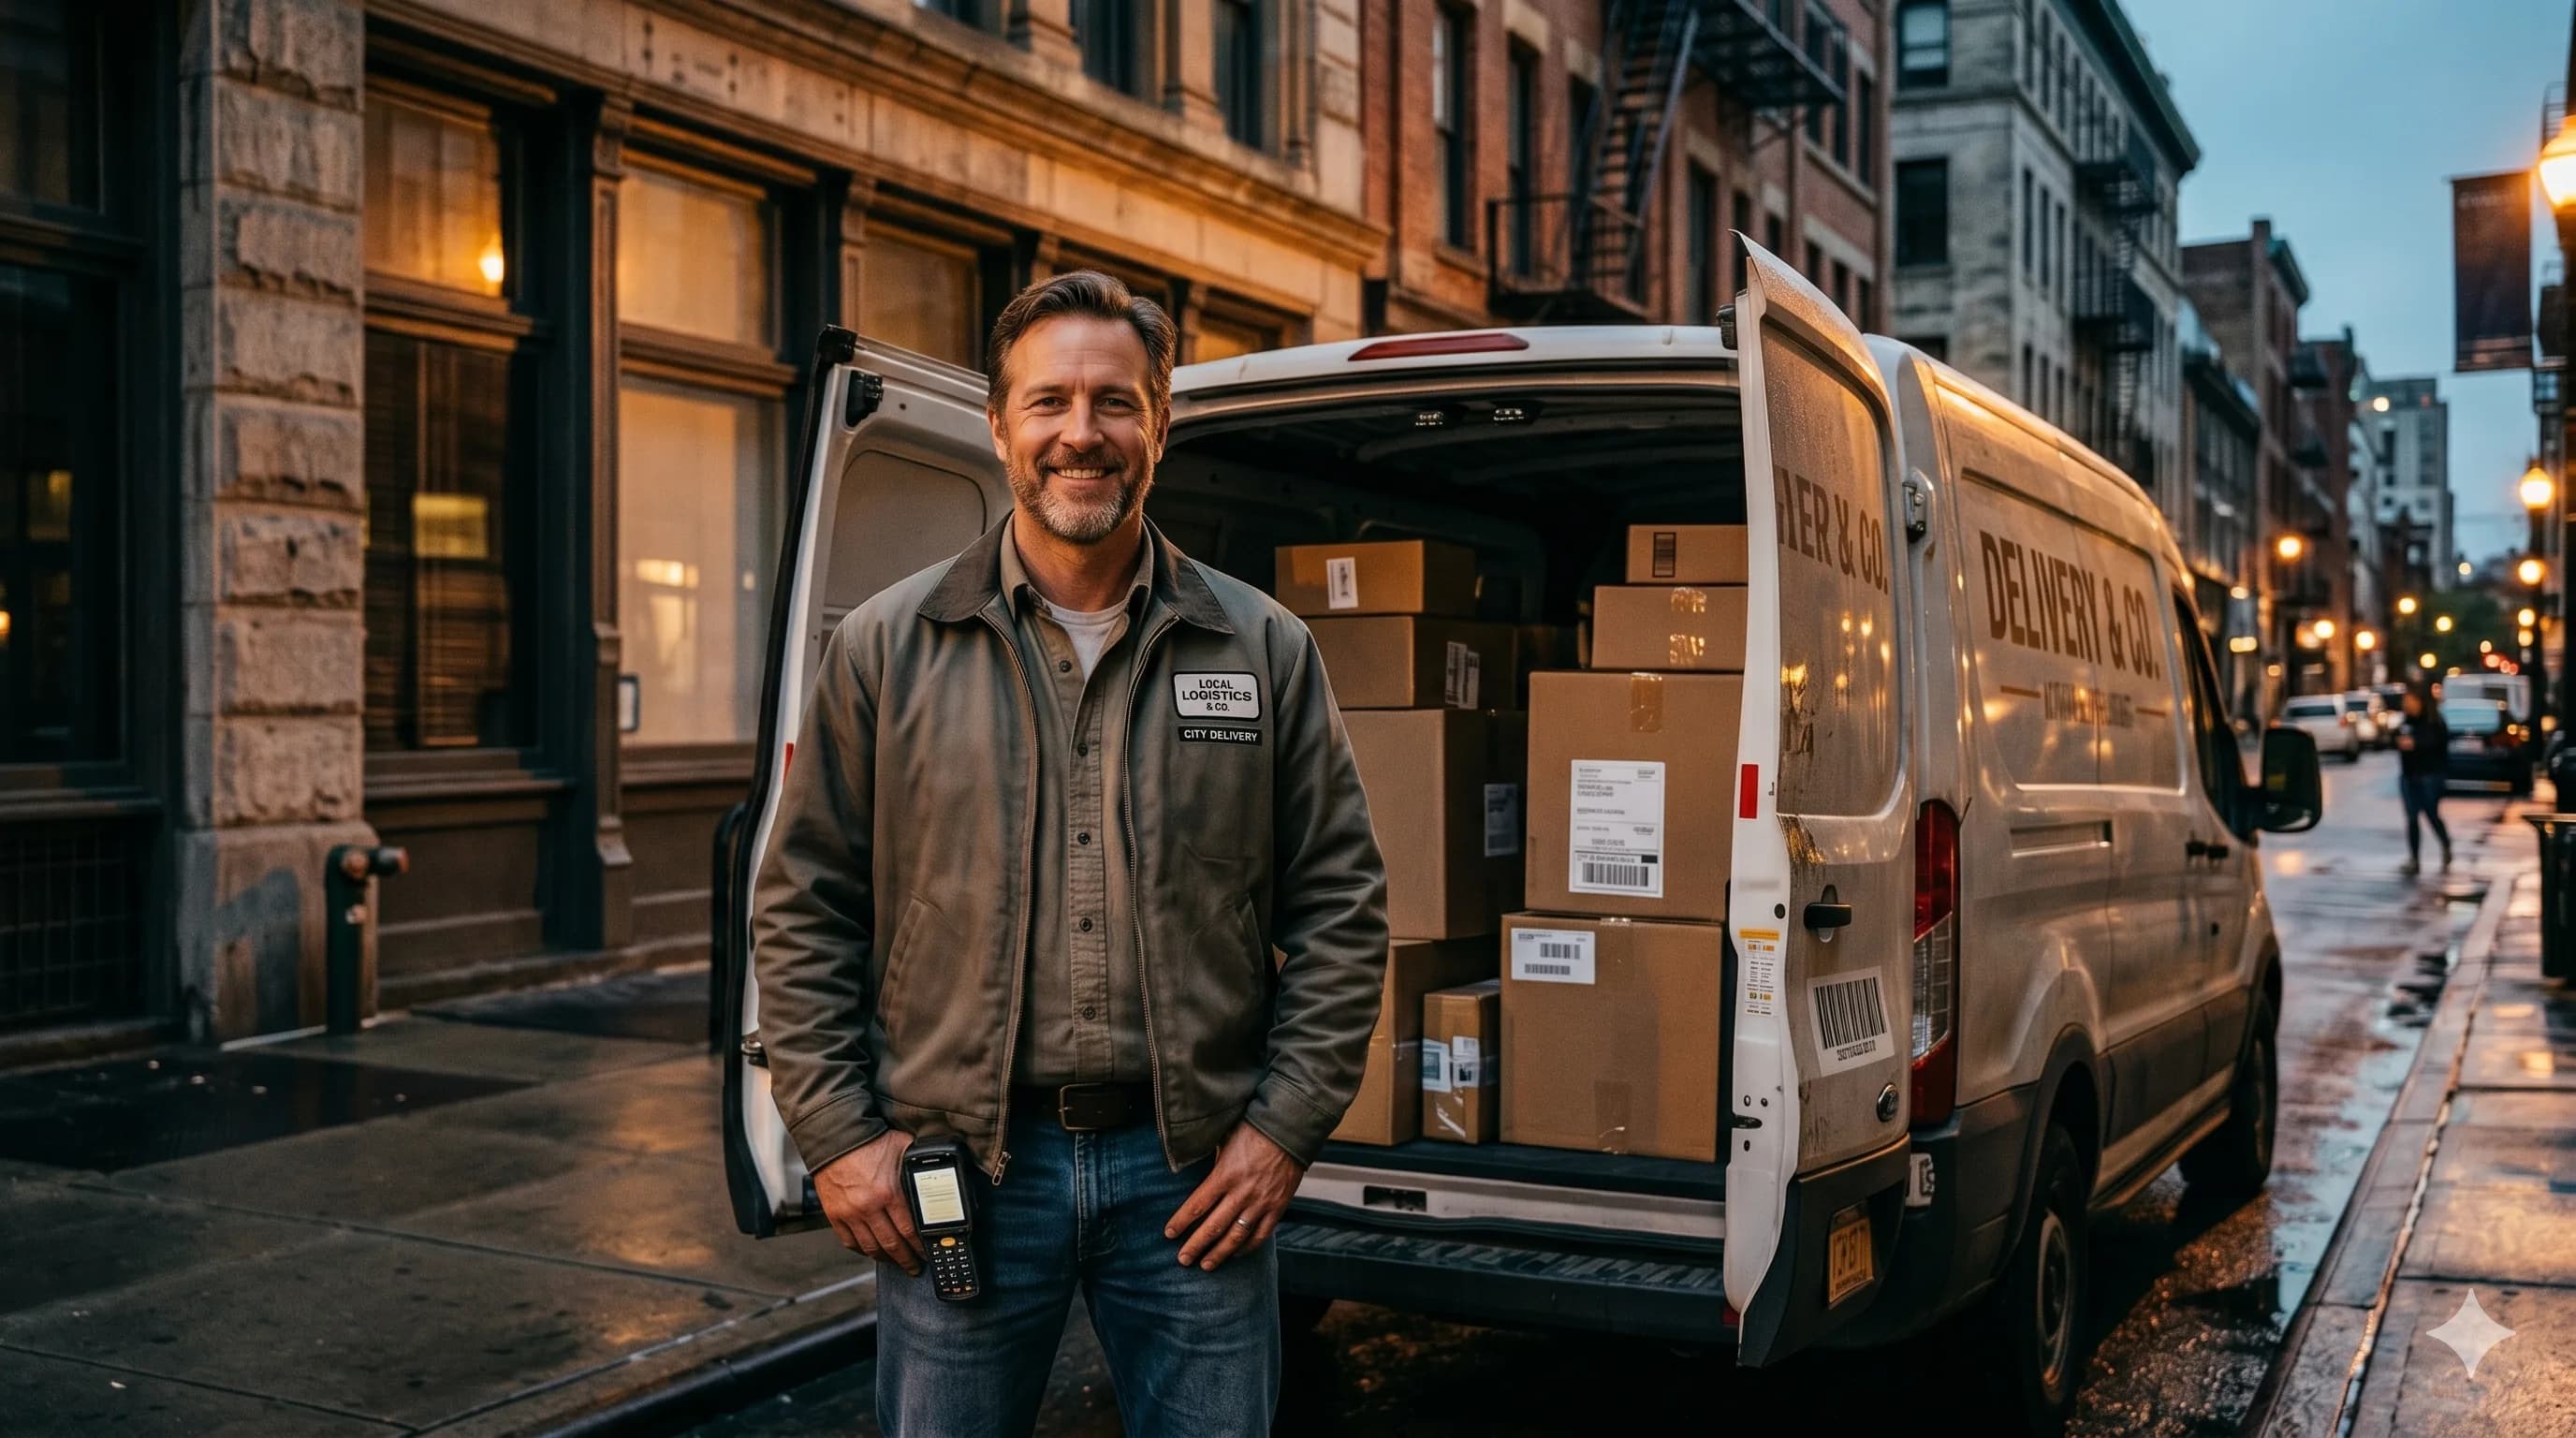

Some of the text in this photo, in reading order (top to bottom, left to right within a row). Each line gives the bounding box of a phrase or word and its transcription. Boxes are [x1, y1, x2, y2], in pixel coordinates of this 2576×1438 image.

[1859, 508, 1888, 595] CO.
[1980, 530, 2160, 682] DELIVERY & CO.
[1199, 679, 1234, 689] LOCAL
[1182, 691, 1252, 701] LOGISTICS
[1206, 703, 1230, 712] & CO.
[1183, 729, 1258, 741] CITY DELIVERY
